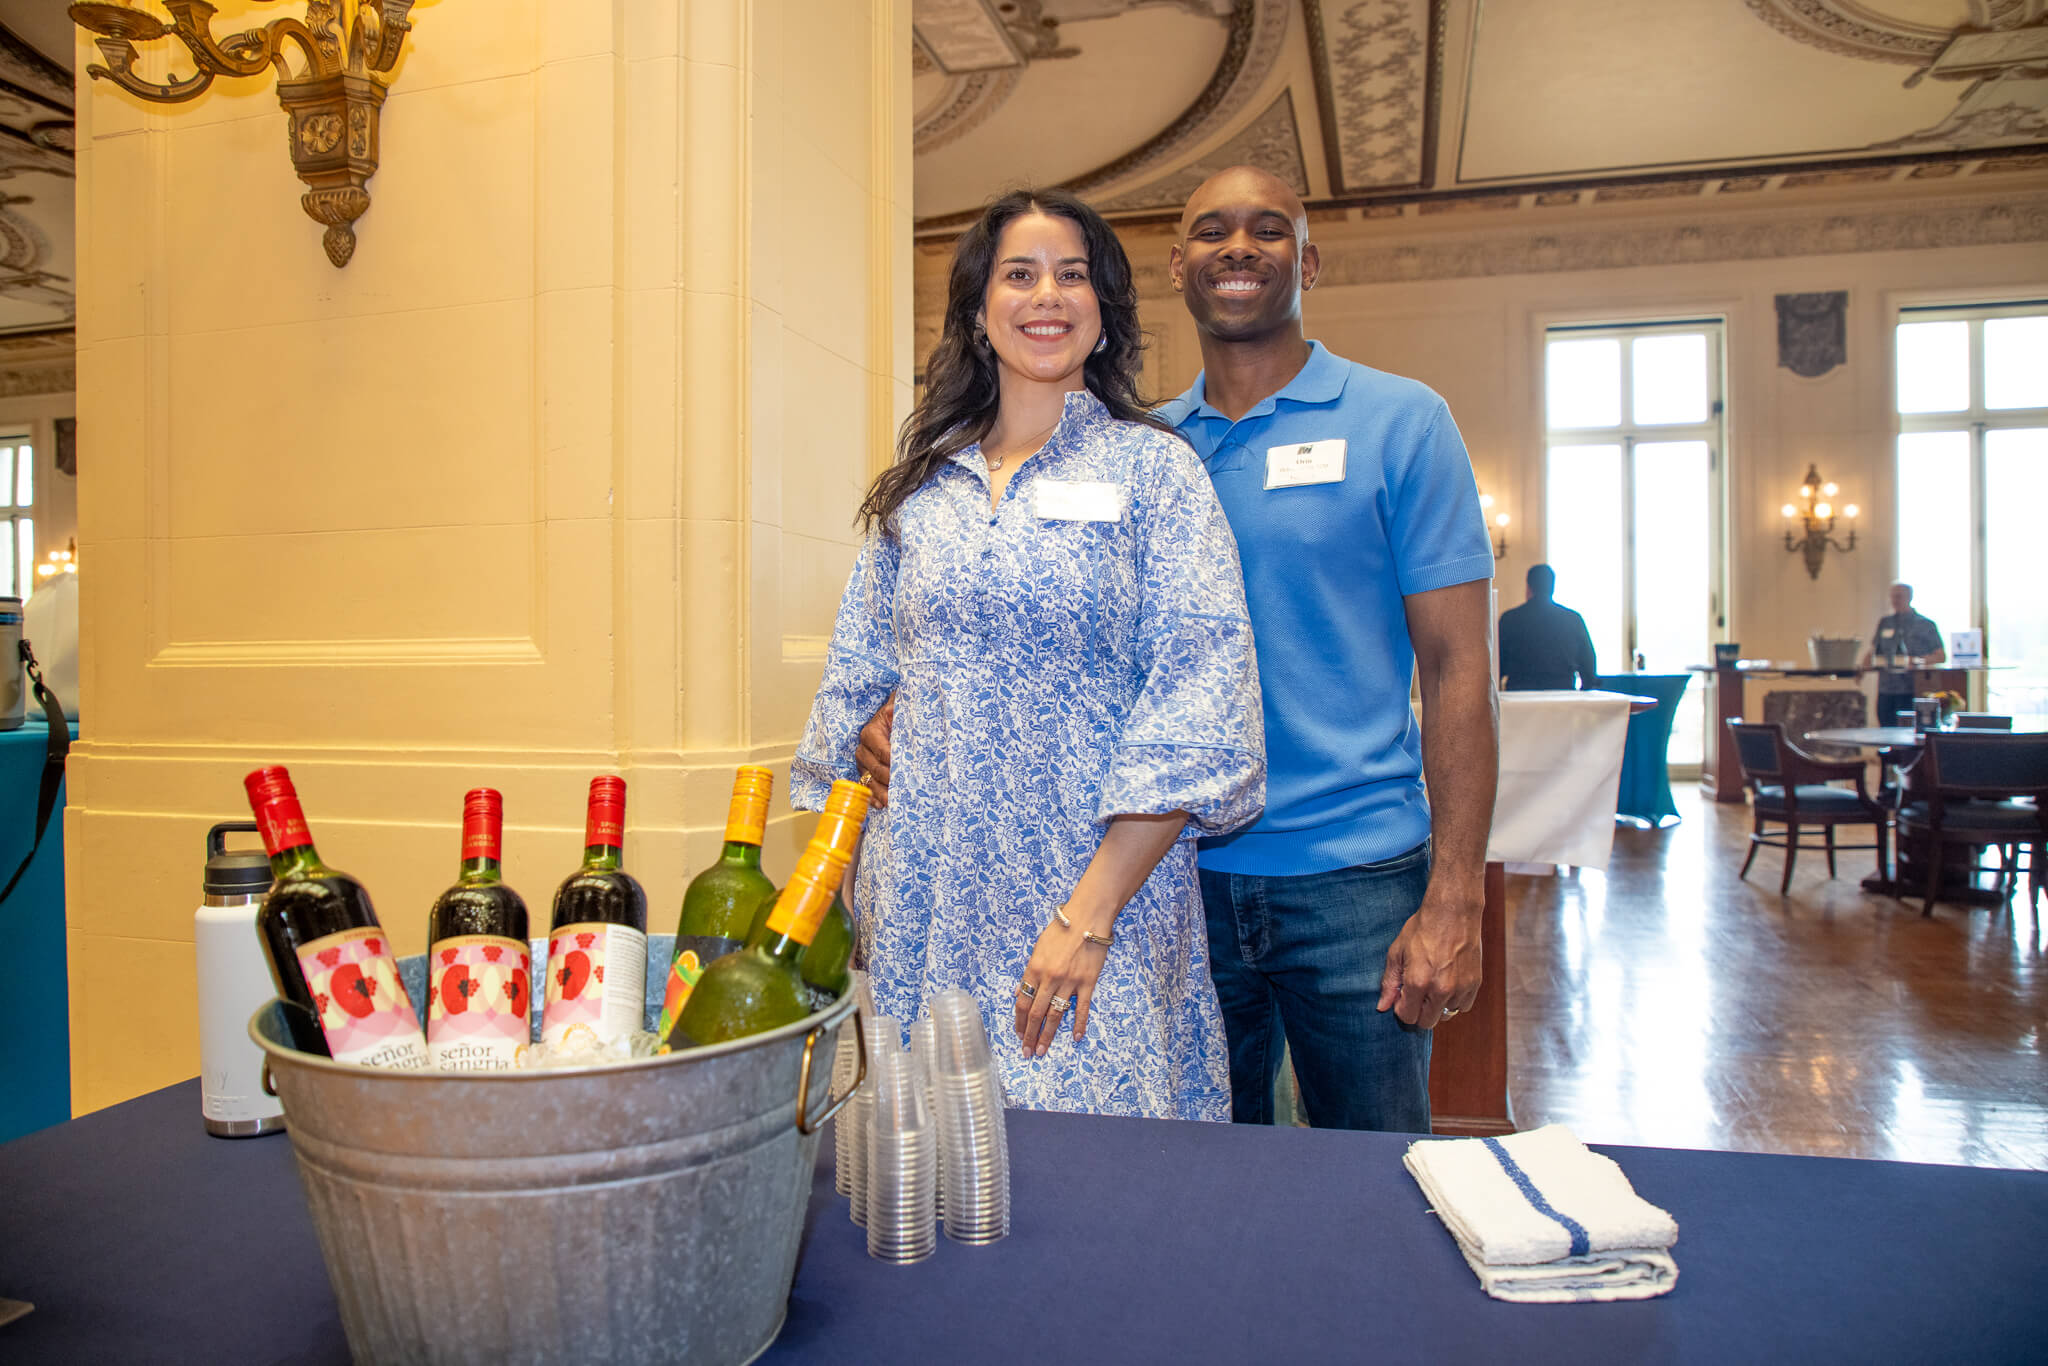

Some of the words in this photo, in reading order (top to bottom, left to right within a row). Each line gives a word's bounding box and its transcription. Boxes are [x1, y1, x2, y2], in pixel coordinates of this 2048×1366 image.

[360, 1043, 414, 1066] señor
[440, 1042, 495, 1059] señor
[440, 1056, 510, 1073] sangria
